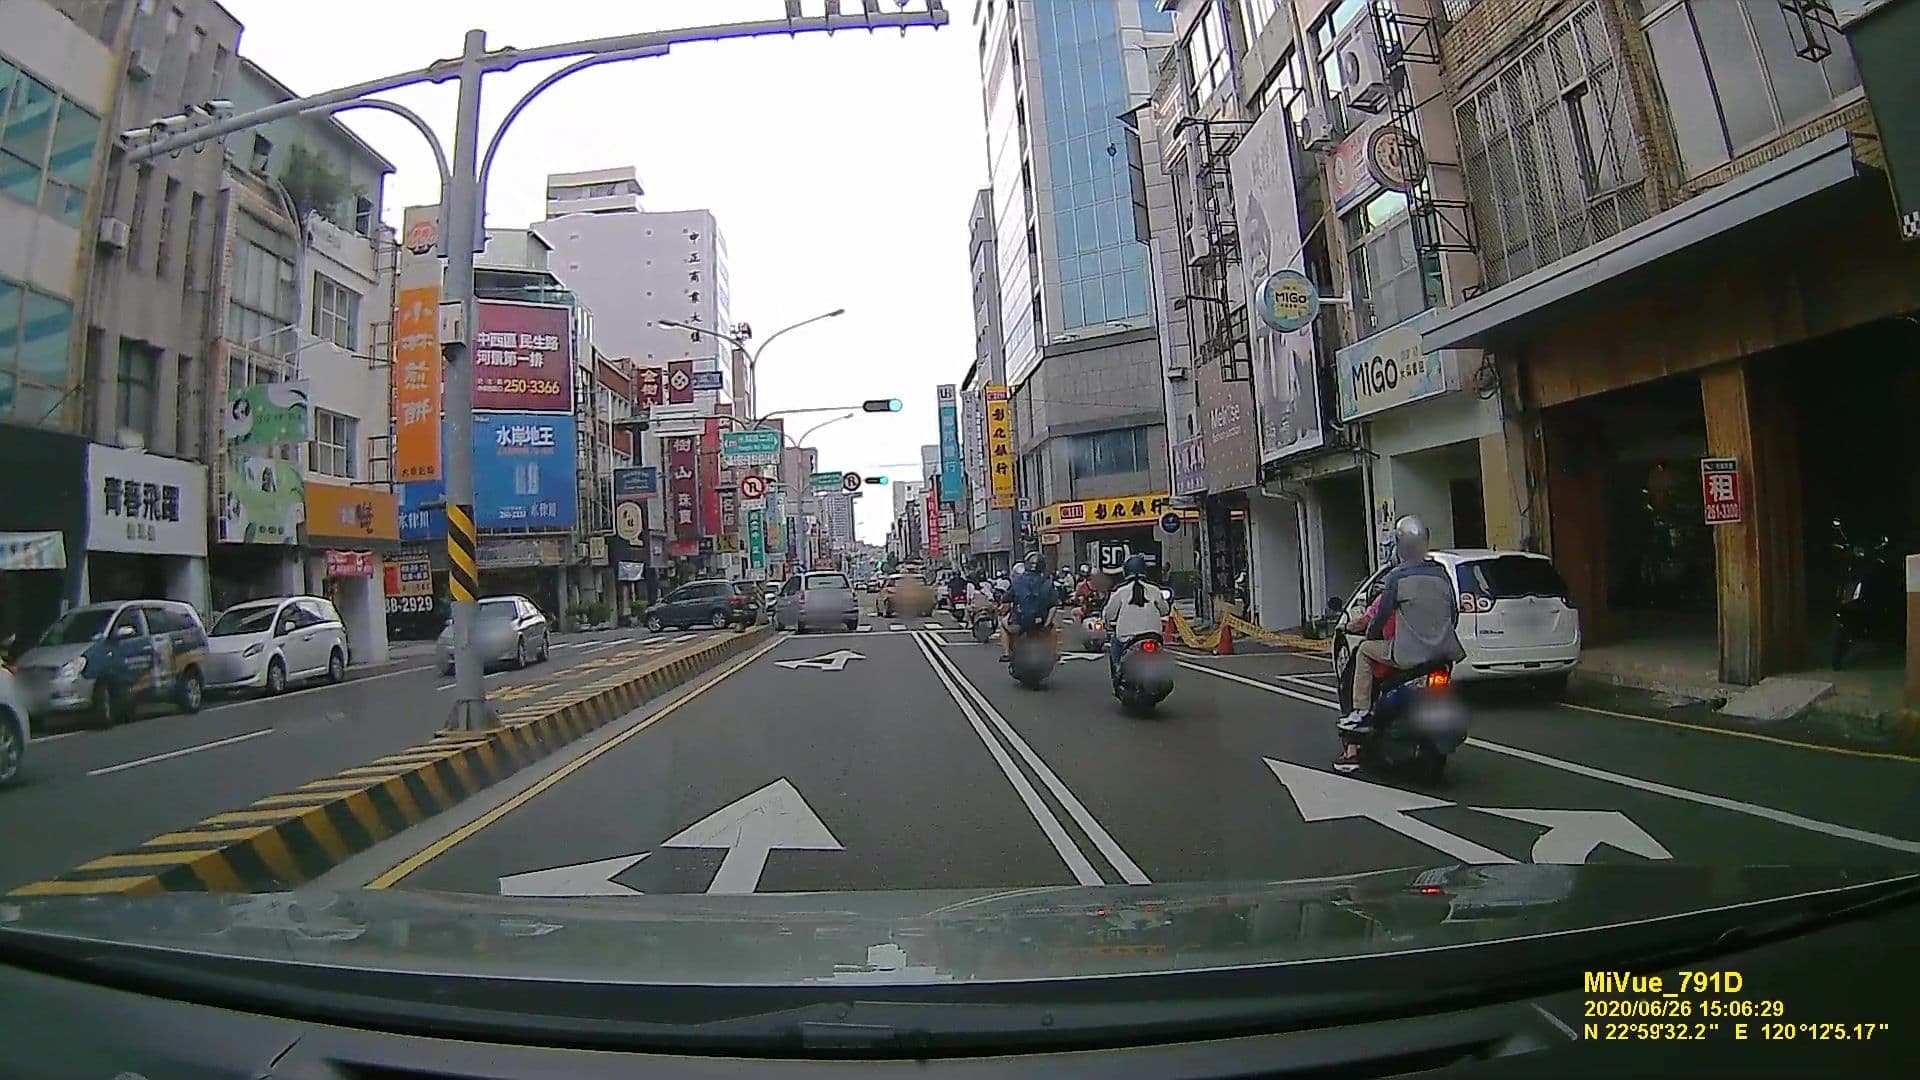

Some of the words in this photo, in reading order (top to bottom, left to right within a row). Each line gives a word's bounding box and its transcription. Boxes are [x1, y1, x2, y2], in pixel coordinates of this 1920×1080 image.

[688, 232, 702, 343] 中正商業大樓
[476, 332, 517, 349] 中西區
[519, 334, 559, 350] 民生路
[476, 352, 544, 368] 河景第一排
[503, 378, 560, 394] 250-3366
[496, 425, 555, 446] 水岸地王
[992, 408, 1008, 476] 彰化銀行
[1709, 475, 1734, 502] 租
[104, 477, 180, 522] 青春飛躍
[1094, 499, 1162, 519] 彰化銀行
